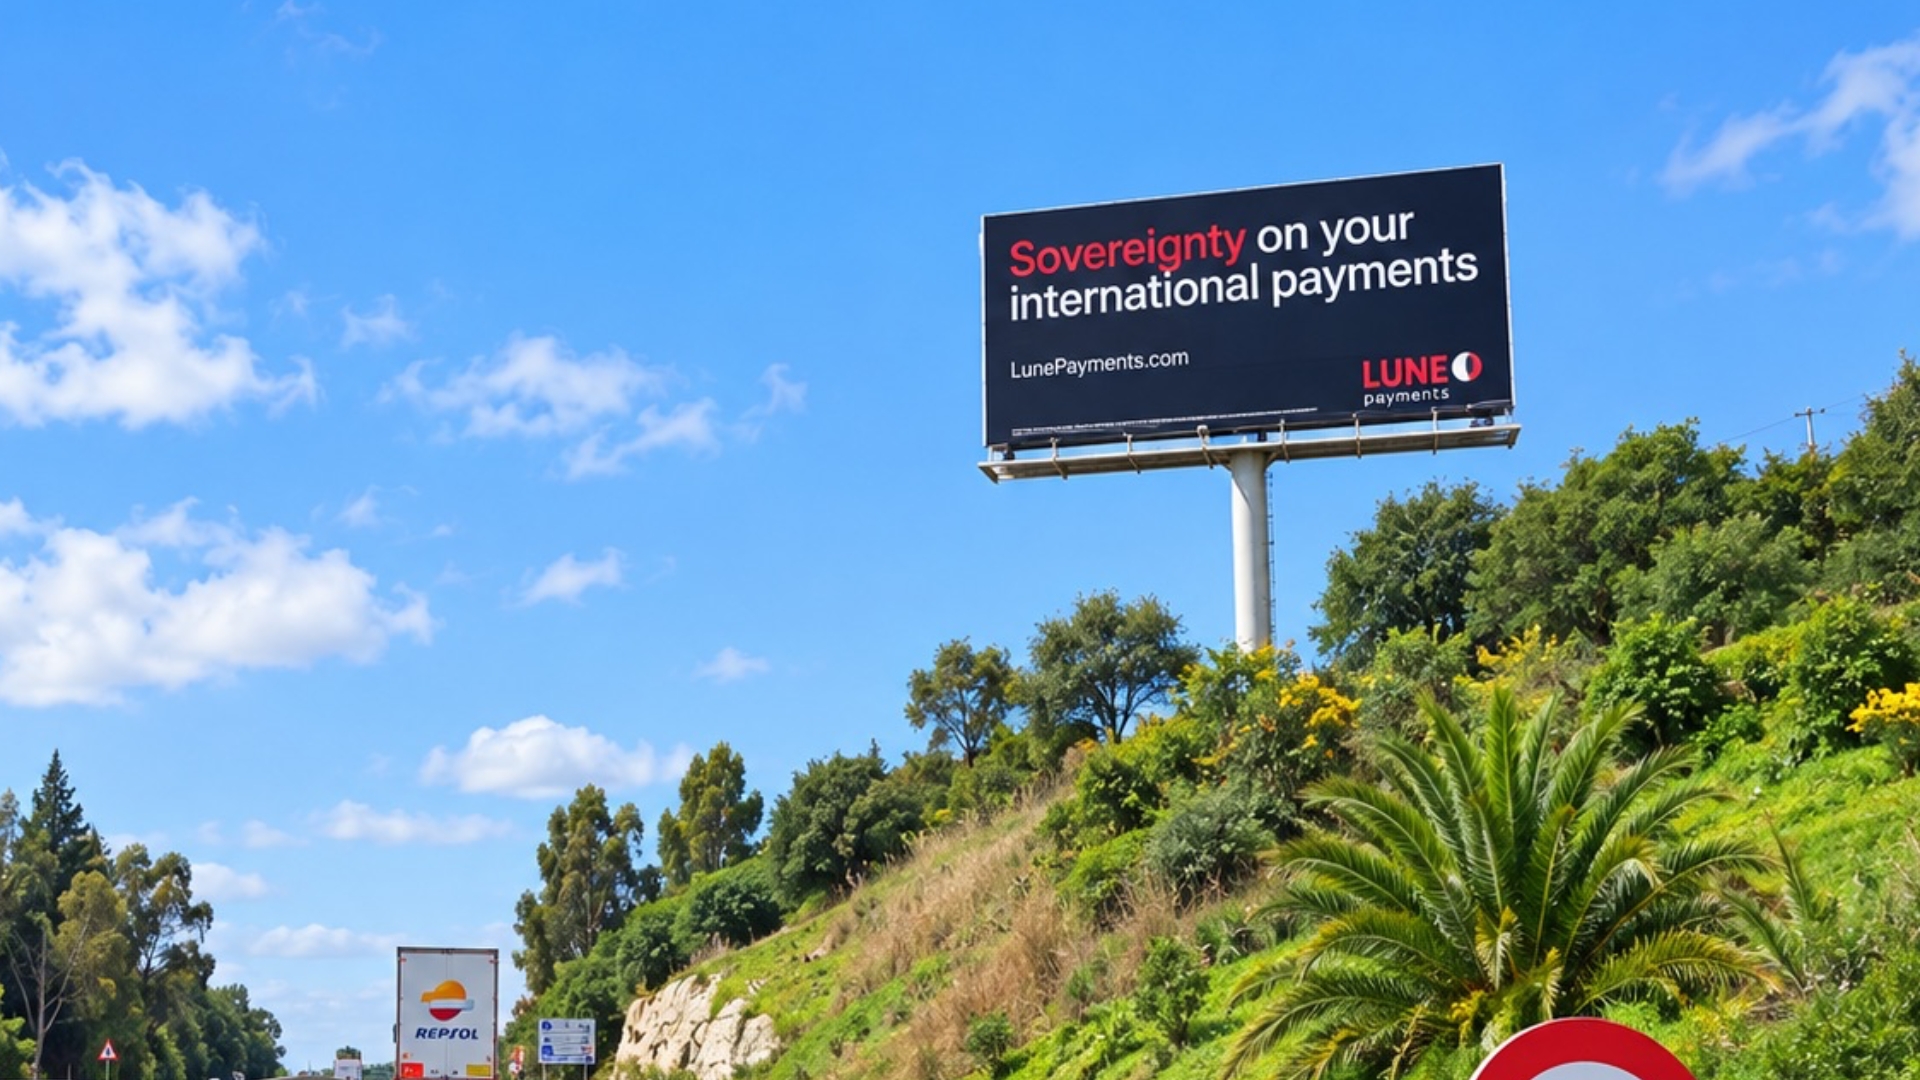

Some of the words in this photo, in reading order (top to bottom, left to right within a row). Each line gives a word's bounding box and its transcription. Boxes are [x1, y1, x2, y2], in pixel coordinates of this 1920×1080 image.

[1010, 224, 1247, 277] Sovereignty
[1257, 221, 1308, 254] on
[1319, 211, 1414, 257] your
[1010, 262, 1260, 321] international
[1272, 248, 1478, 307] payments
[1010, 350, 1189, 380] LunePayments.com
[1362, 354, 1449, 388] LUNE
[1364, 387, 1450, 407] payments
[415, 1028, 479, 1040] REPSOL
